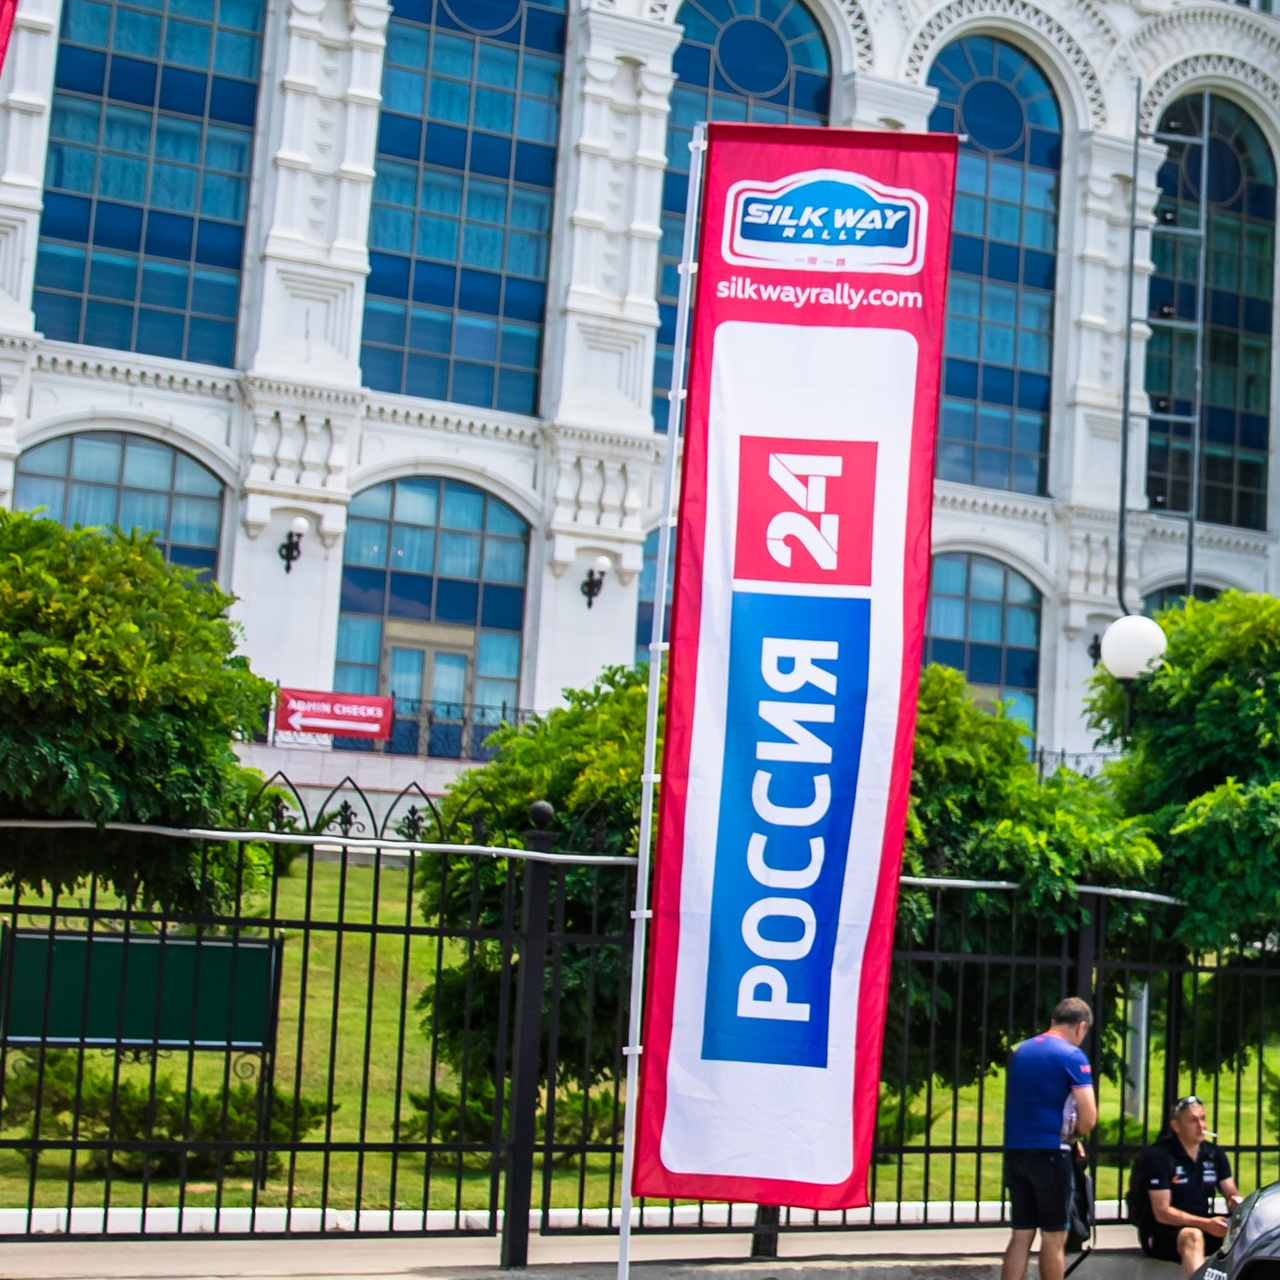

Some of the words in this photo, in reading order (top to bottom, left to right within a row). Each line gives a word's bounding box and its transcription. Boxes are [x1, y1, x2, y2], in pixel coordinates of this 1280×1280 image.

[743, 202, 829, 227] SILK
[834, 208, 907, 231] WAY
[782, 227, 866, 241] RALLY
[716, 276, 923, 310] silkwayrally.com
[765, 452, 843, 571] 24
[287, 699, 331, 714] ADMIN
[333, 703, 384, 719] CHECKS
[736, 637, 839, 1022] РОССИЯ
